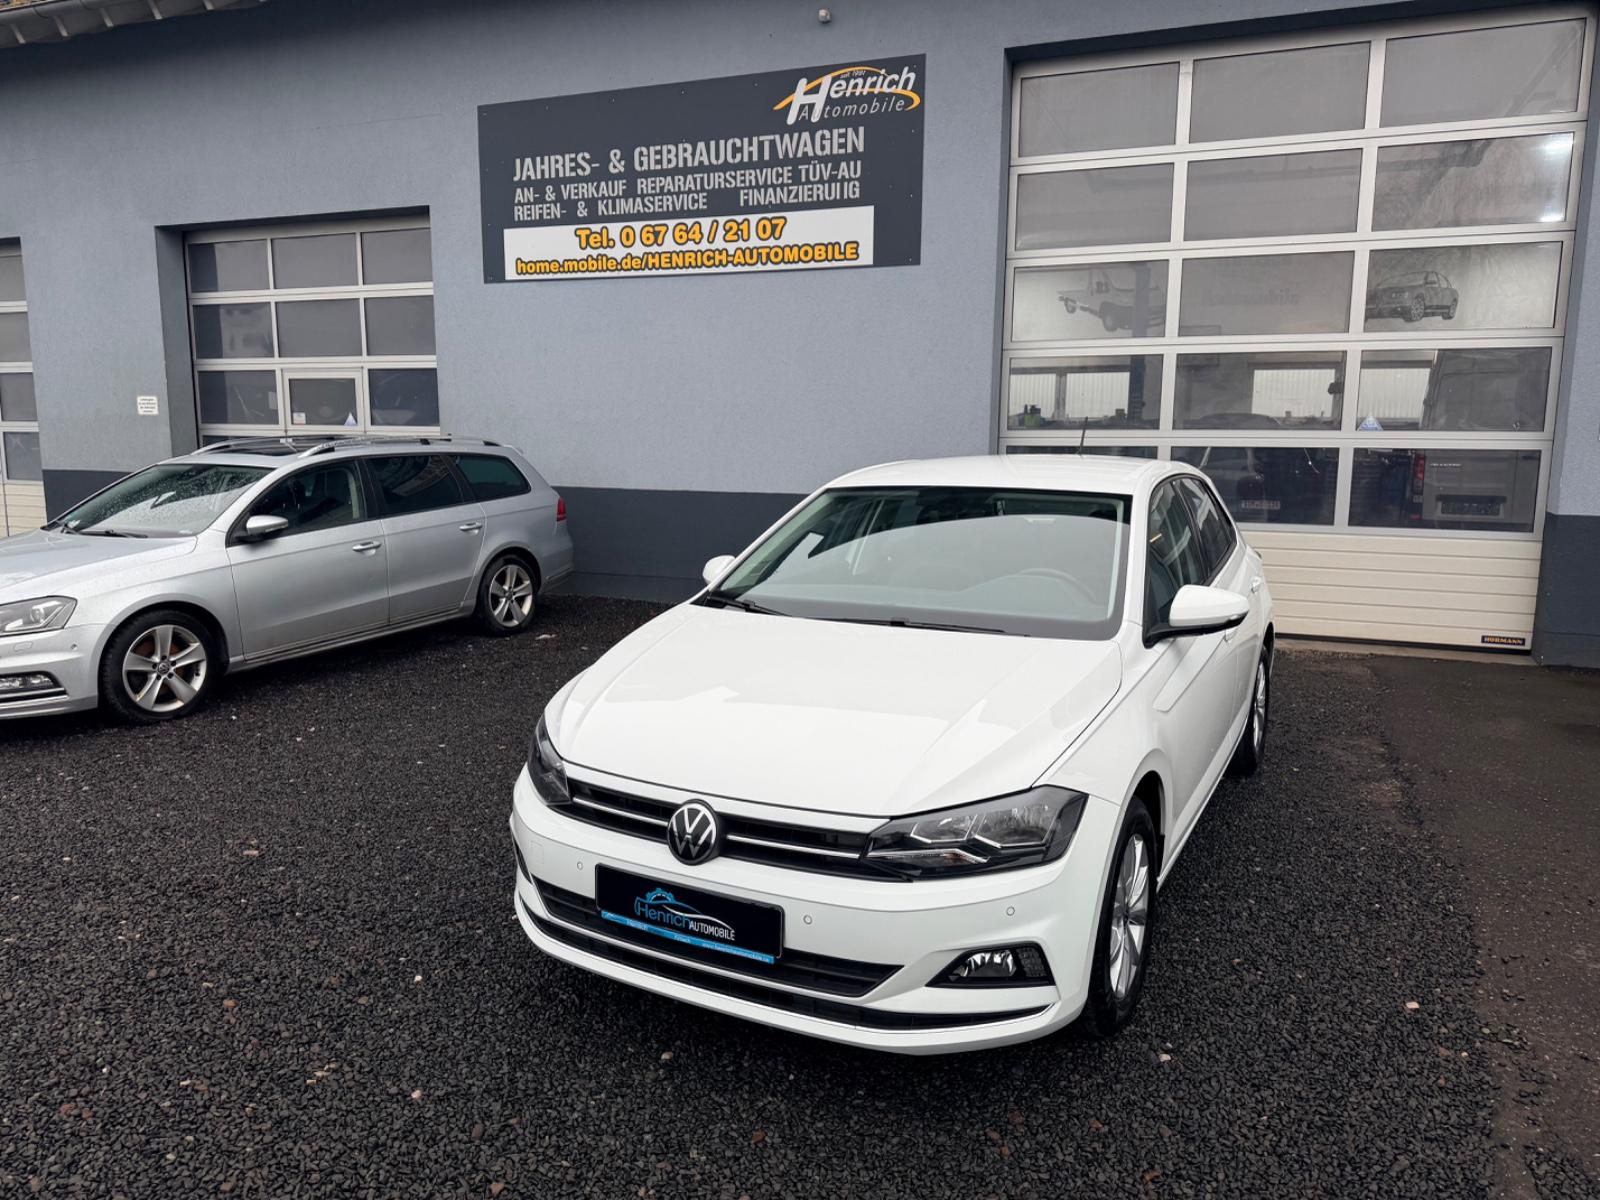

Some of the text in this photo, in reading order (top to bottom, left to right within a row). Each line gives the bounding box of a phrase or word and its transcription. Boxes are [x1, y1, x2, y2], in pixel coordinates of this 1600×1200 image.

[786, 66, 916, 125] Henrich
[513, 126, 865, 181] JAHRES- & GEBRAUCHTWAGEN
[514, 160, 862, 203] AN- & VERKAUF REPARATURSERVICE TÜV-AU
[514, 203, 567, 221] REIFEN-
[577, 201, 588, 217] &
[598, 193, 707, 216] KLIMASERVICE
[575, 216, 787, 250] Tel. 0 67 64 / 21 07
[516, 241, 859, 276] home.mobile.de/HENRICH-AUTOMOBILE
[689, 920, 736, 942] AUTOMOBILE
